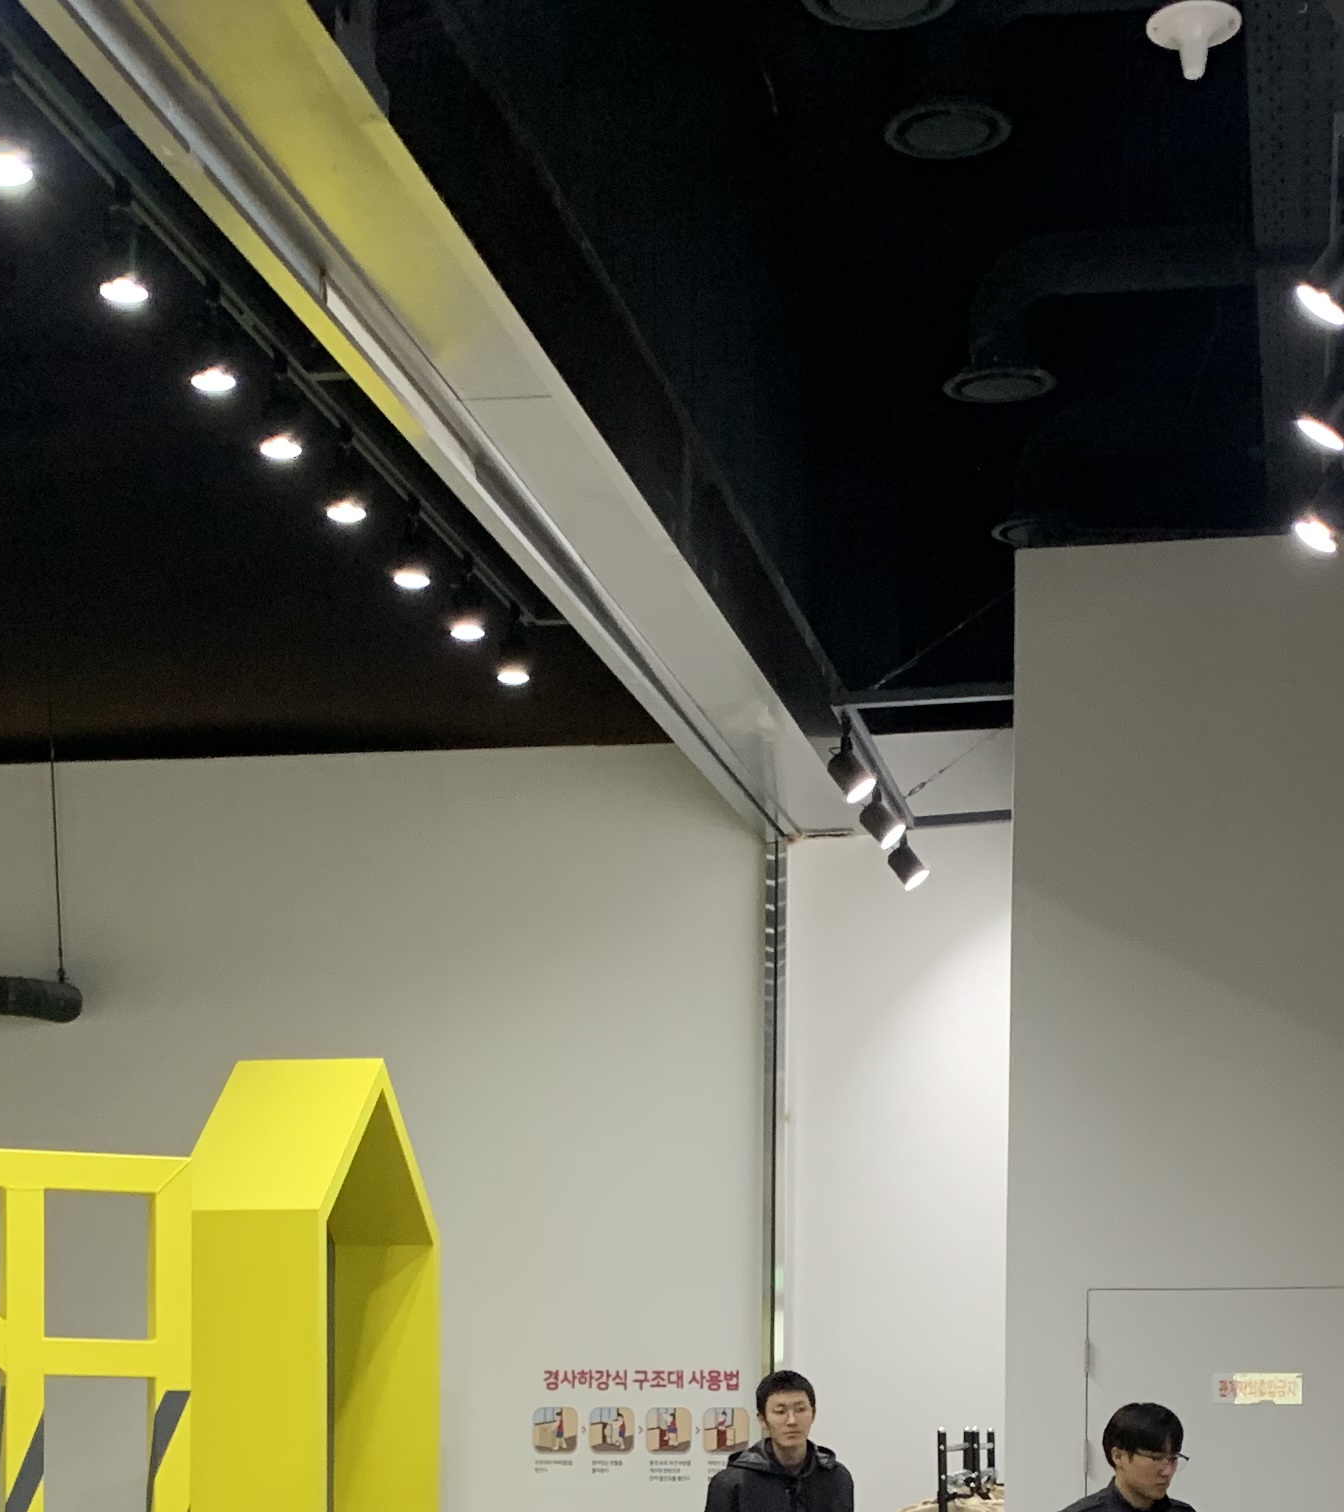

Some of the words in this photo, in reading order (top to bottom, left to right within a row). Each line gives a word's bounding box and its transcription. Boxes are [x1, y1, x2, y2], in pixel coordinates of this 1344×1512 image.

[543, 1369, 628, 1391] 경사하강식
[633, 1369, 685, 1391] 구조대
[688, 1369, 741, 1391] 사용법
